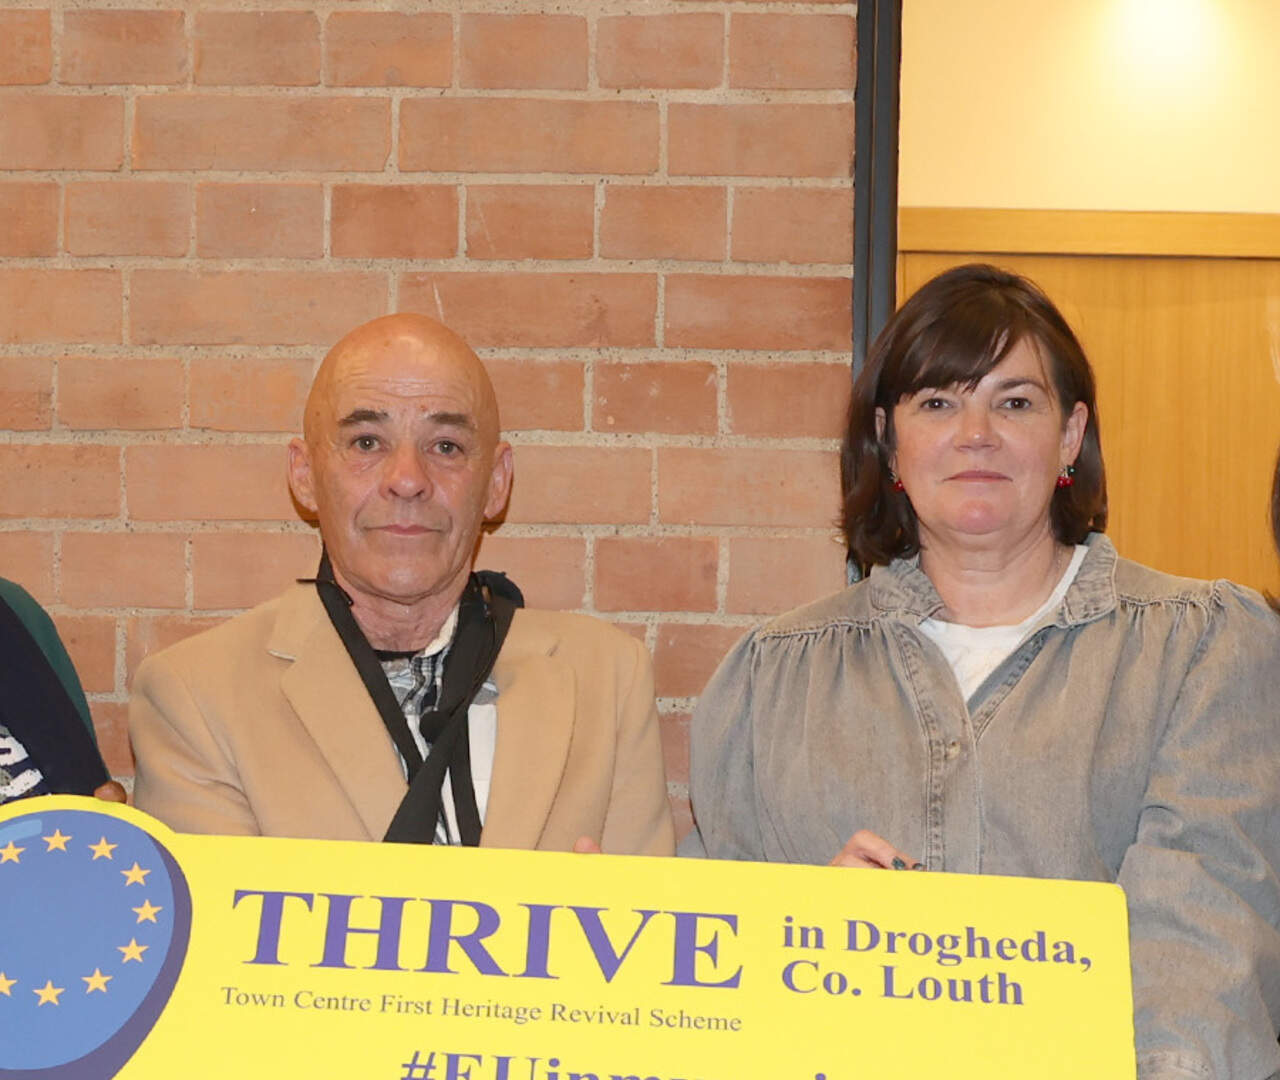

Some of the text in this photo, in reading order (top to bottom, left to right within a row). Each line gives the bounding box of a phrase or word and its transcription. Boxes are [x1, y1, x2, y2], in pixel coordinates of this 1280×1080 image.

[231, 889, 743, 989] THRIVE
[782, 915, 1092, 972] in Drogheda,
[781, 960, 1024, 1006] Co. Louth
[220, 987, 743, 1032] Town Centre First Heritage Revival Scheme
